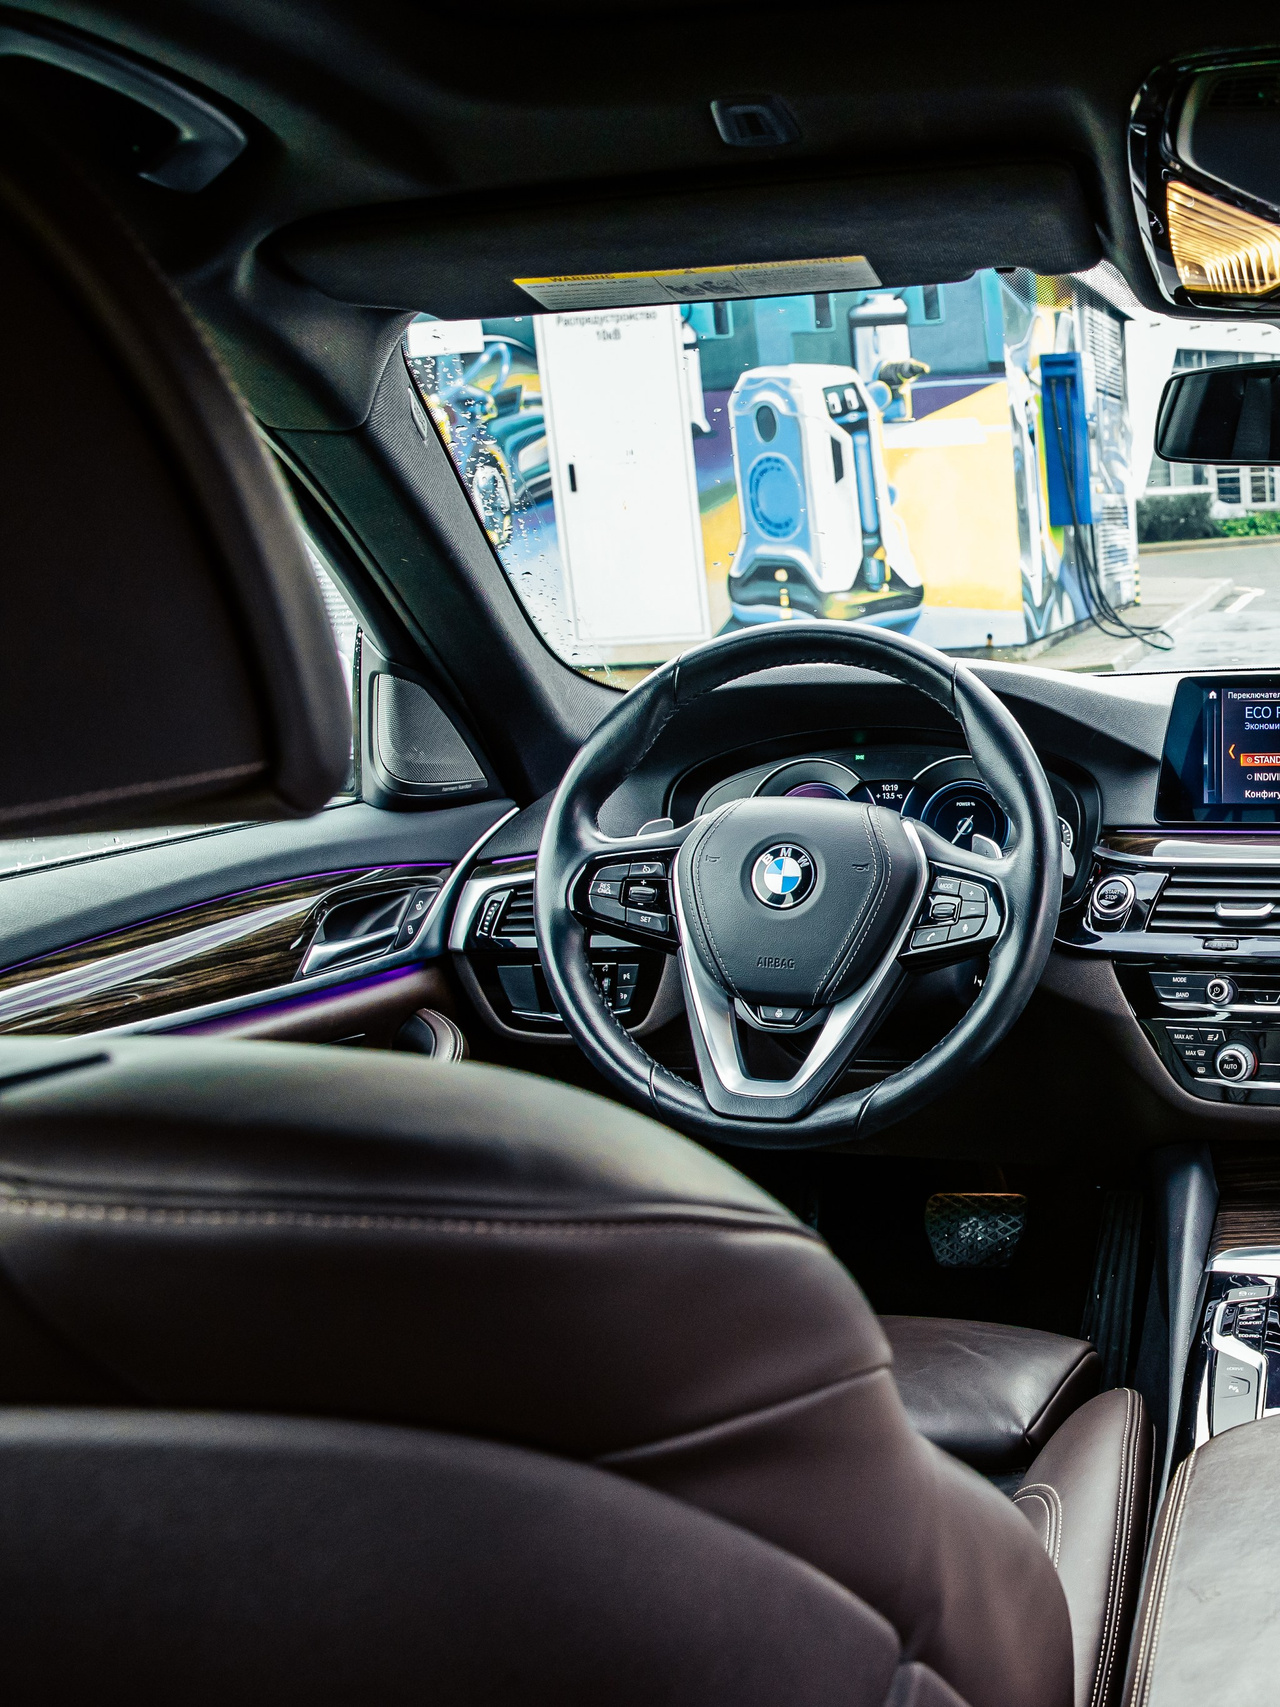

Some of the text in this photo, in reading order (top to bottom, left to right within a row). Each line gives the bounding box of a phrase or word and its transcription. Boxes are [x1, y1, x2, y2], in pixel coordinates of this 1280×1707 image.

[549, 274, 616, 283] WARNING
[1244, 706, 1272, 719] ECO
[881, 784, 899, 792] 10:19
[882, 792, 895, 800] 13.5
[761, 847, 810, 868] BMW
[640, 915, 652, 923] SET
[756, 955, 796, 970] AIRBAG
